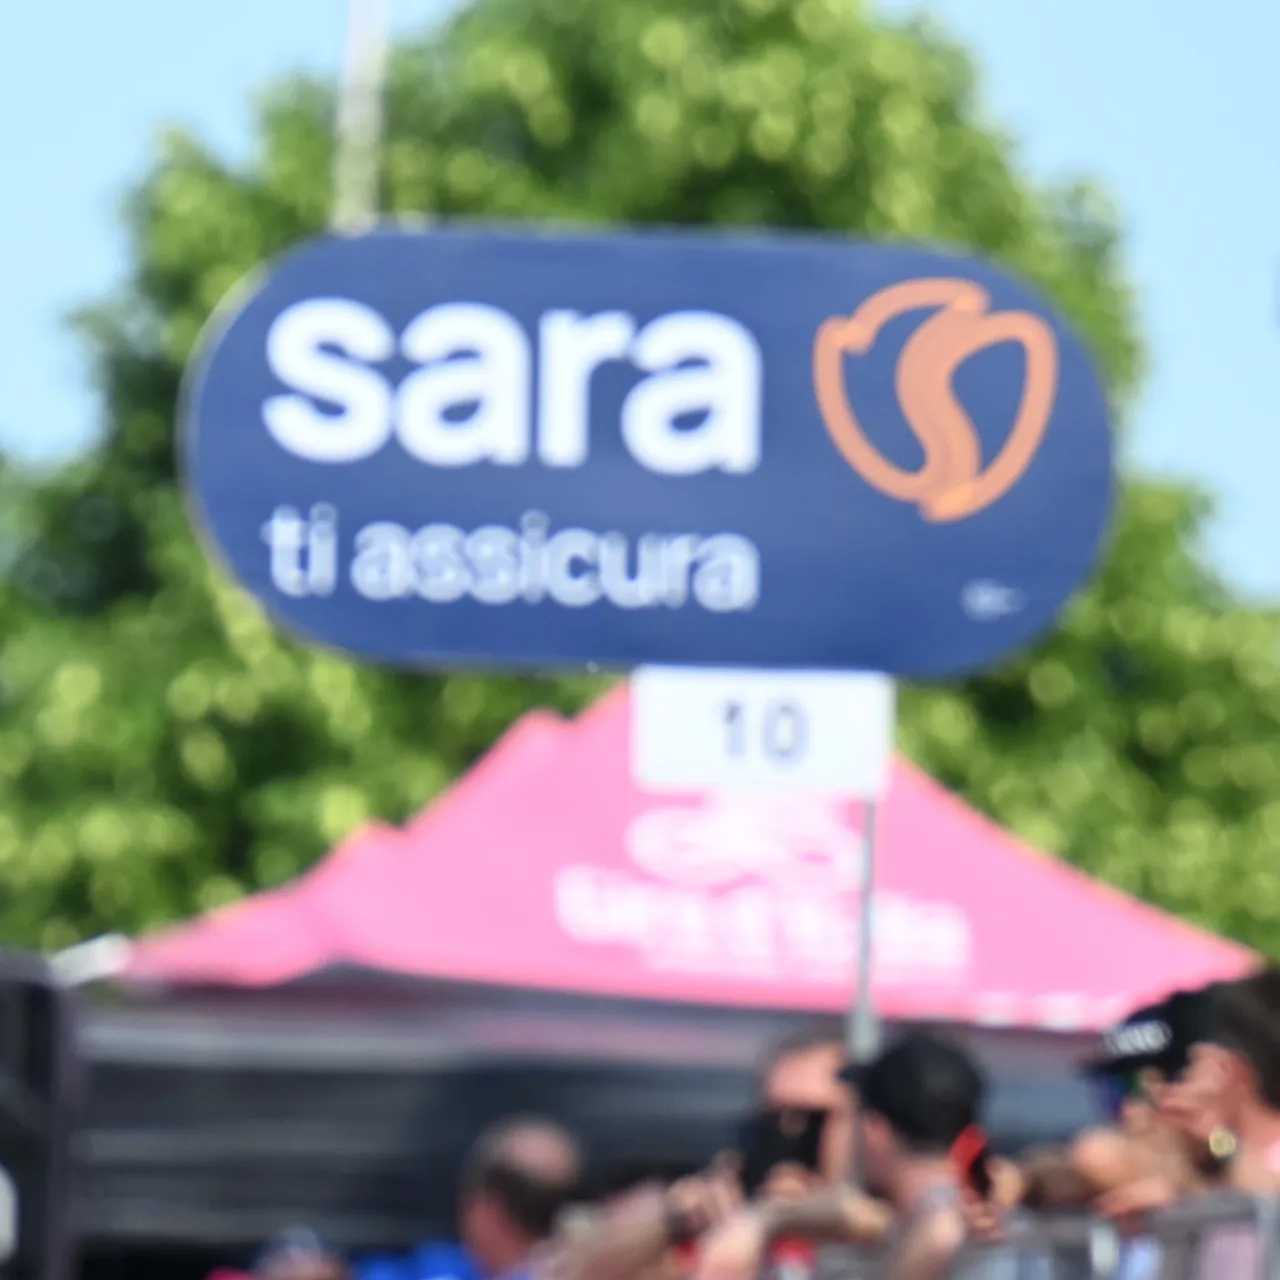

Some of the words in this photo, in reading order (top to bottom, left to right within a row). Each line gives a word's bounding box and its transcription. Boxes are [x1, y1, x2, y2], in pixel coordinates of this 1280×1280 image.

[262, 296, 762, 475] sara
[262, 505, 337, 597] ti
[350, 508, 760, 612] assicura
[721, 699, 810, 766] 10
